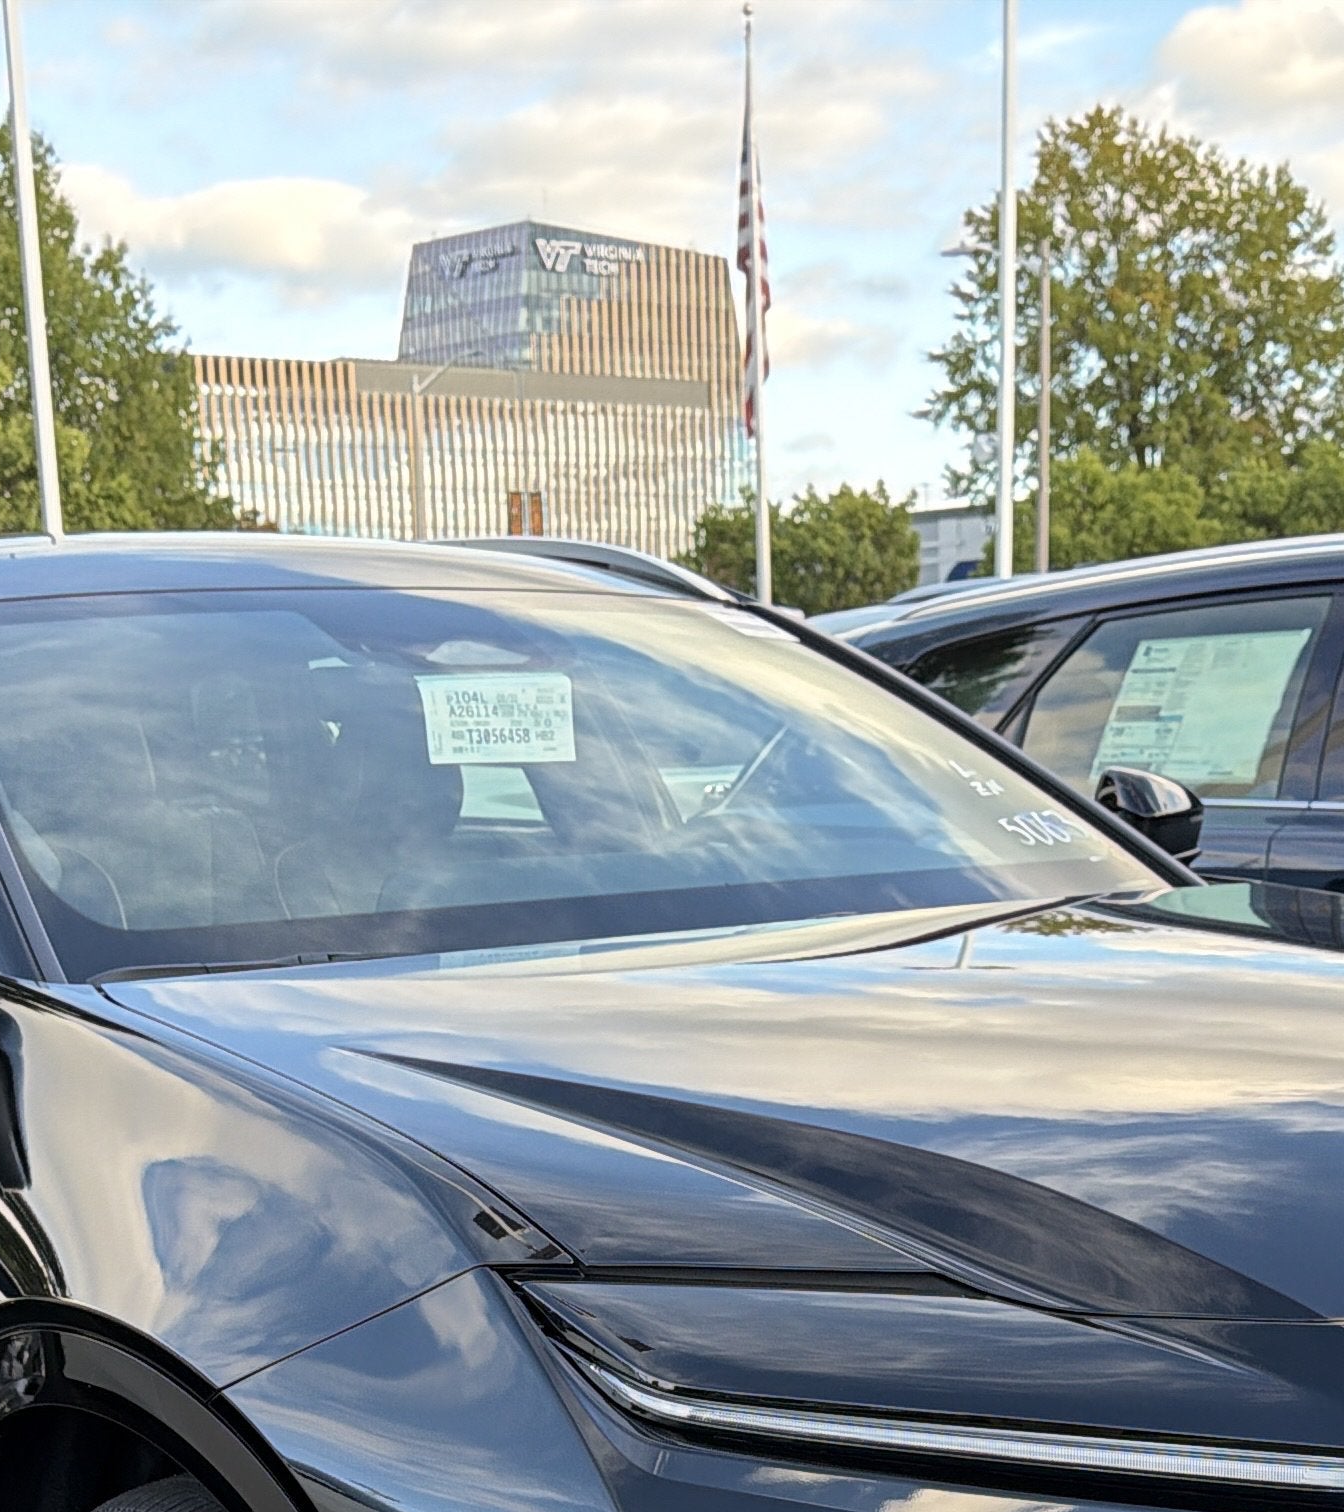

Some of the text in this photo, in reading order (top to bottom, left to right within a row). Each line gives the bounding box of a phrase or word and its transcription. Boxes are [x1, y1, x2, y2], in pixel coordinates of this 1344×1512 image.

[536, 239, 582, 272] VT
[583, 244, 646, 263] VIRGINIA
[466, 728, 531, 745] T3056458
